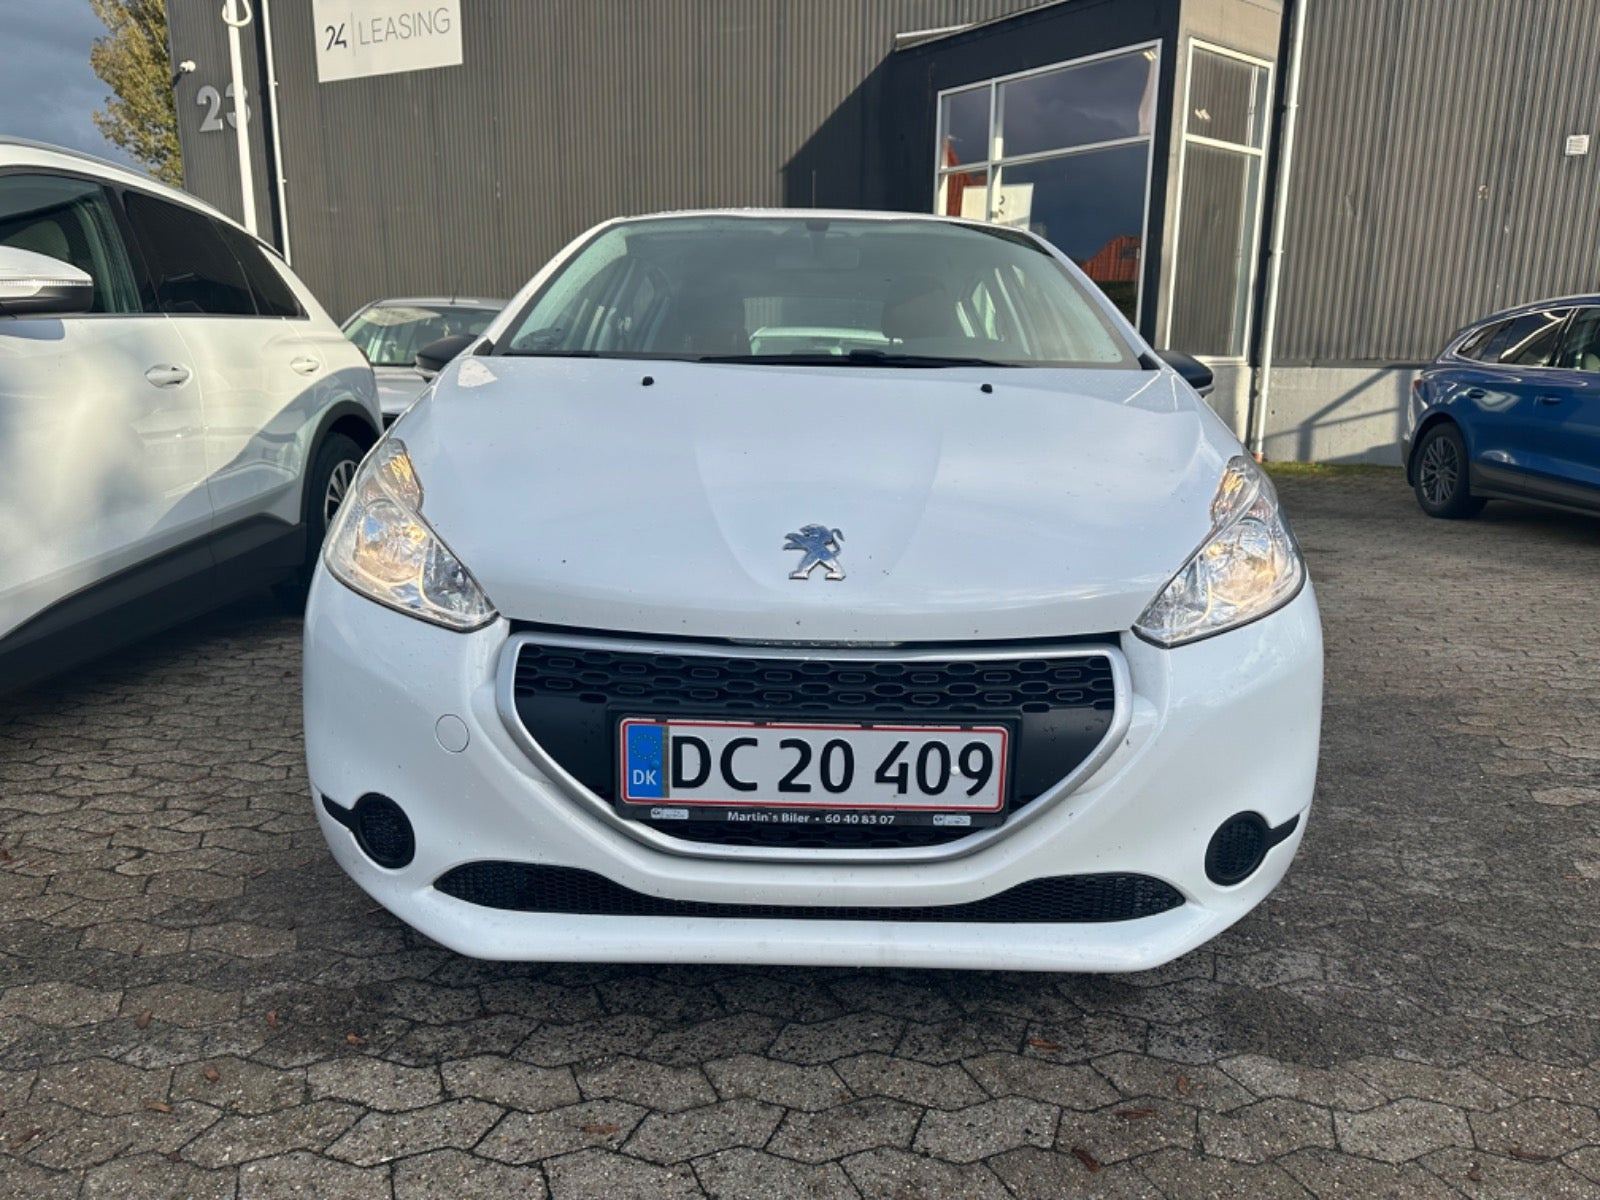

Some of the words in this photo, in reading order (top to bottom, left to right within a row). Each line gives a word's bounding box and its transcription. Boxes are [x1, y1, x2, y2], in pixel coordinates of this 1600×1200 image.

[358, 7, 451, 46] LEASING
[633, 769, 657, 786] DK
[671, 735, 758, 791] DC
[777, 738, 855, 794] 20
[874, 740, 993, 797] 409
[782, 812, 810, 823] Biler
[825, 813, 841, 824] 60
[843, 814, 858, 824] 40
[861, 814, 876, 825] 83
[879, 815, 895, 825] 07
